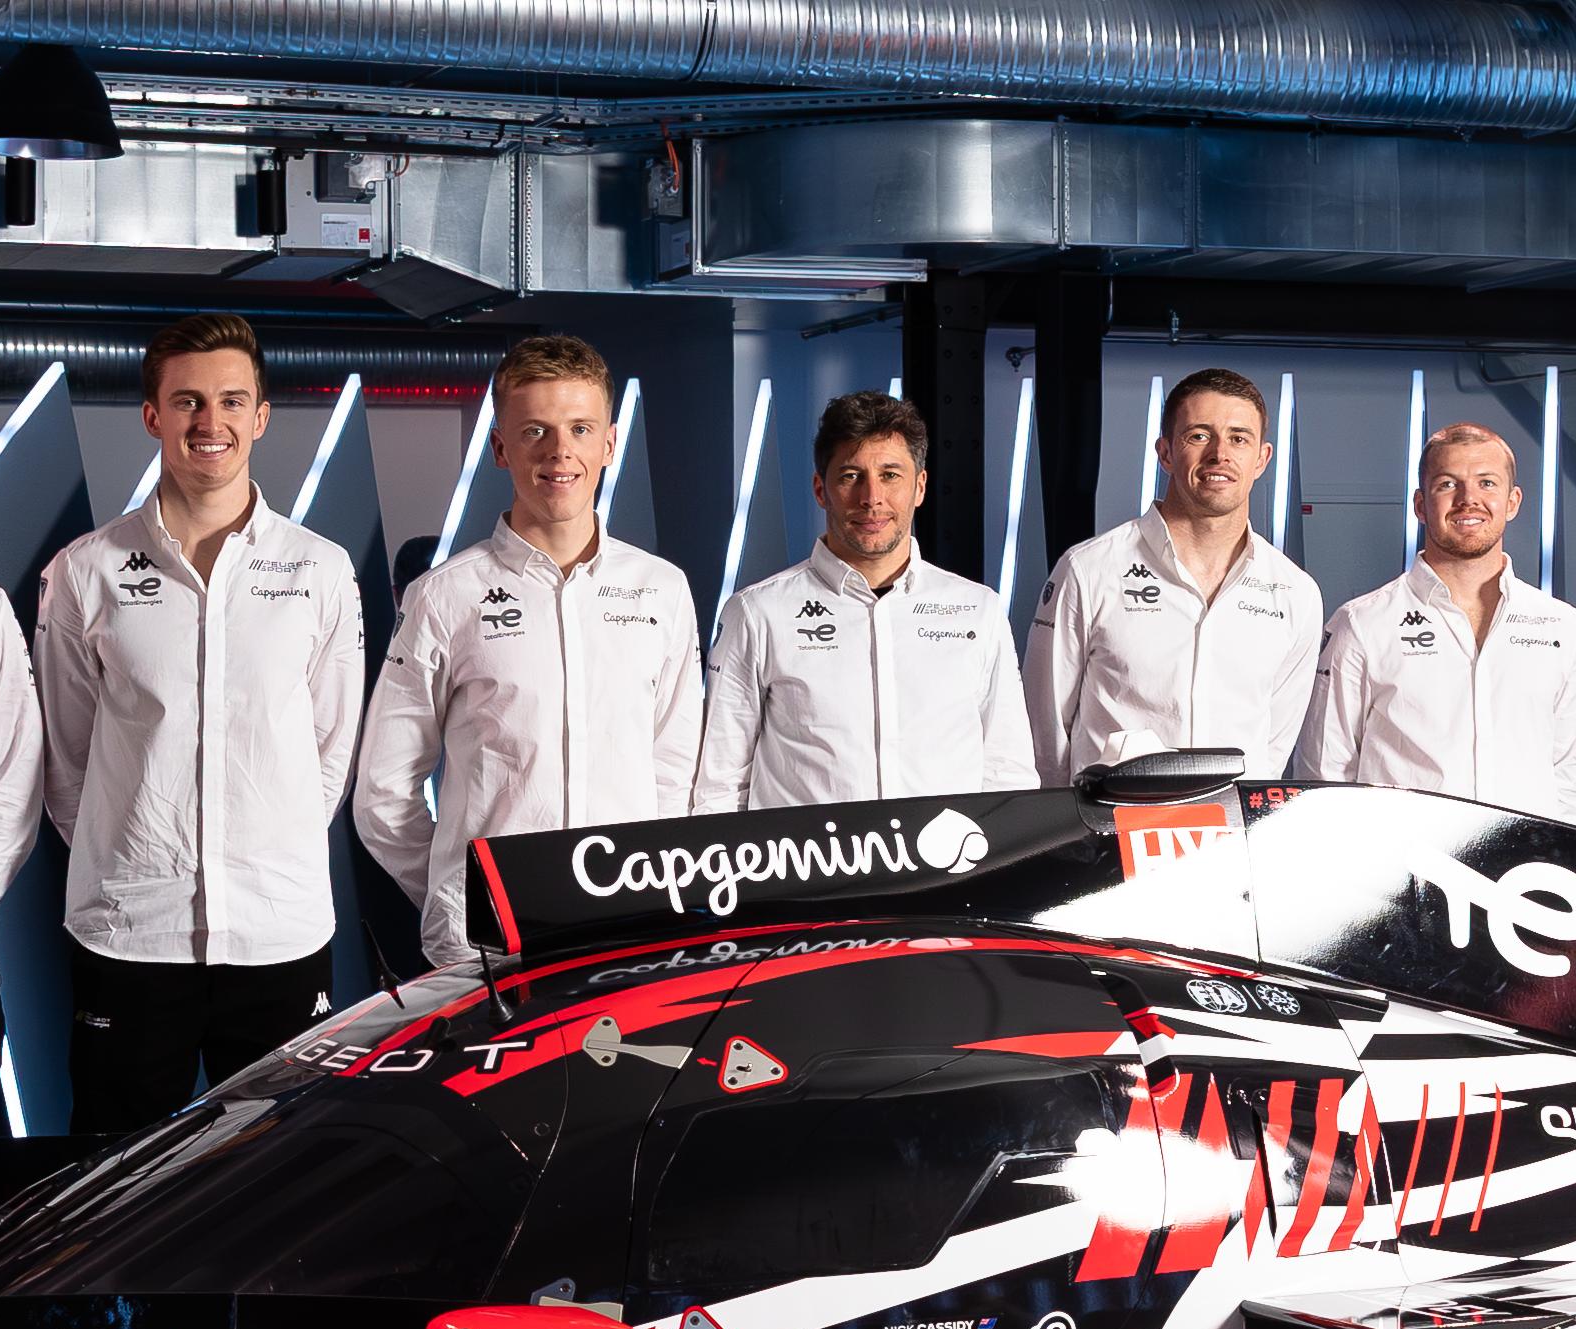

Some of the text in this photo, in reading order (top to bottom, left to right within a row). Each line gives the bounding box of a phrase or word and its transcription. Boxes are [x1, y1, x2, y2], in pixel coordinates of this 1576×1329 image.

[260, 566, 298, 574] SPORT
[264, 560, 319, 570] PEUGEOT
[251, 586, 303, 600] Capgemini
[610, 586, 658, 596] PEUGEOT
[119, 599, 163, 607] TotalEnergies
[603, 613, 648, 626] Capgemini
[483, 630, 525, 640] TotalEnergies
[917, 627, 966, 641] Capgemini
[1510, 635, 1553, 649] Capgemini
[572, 819, 918, 917] Capgemini
